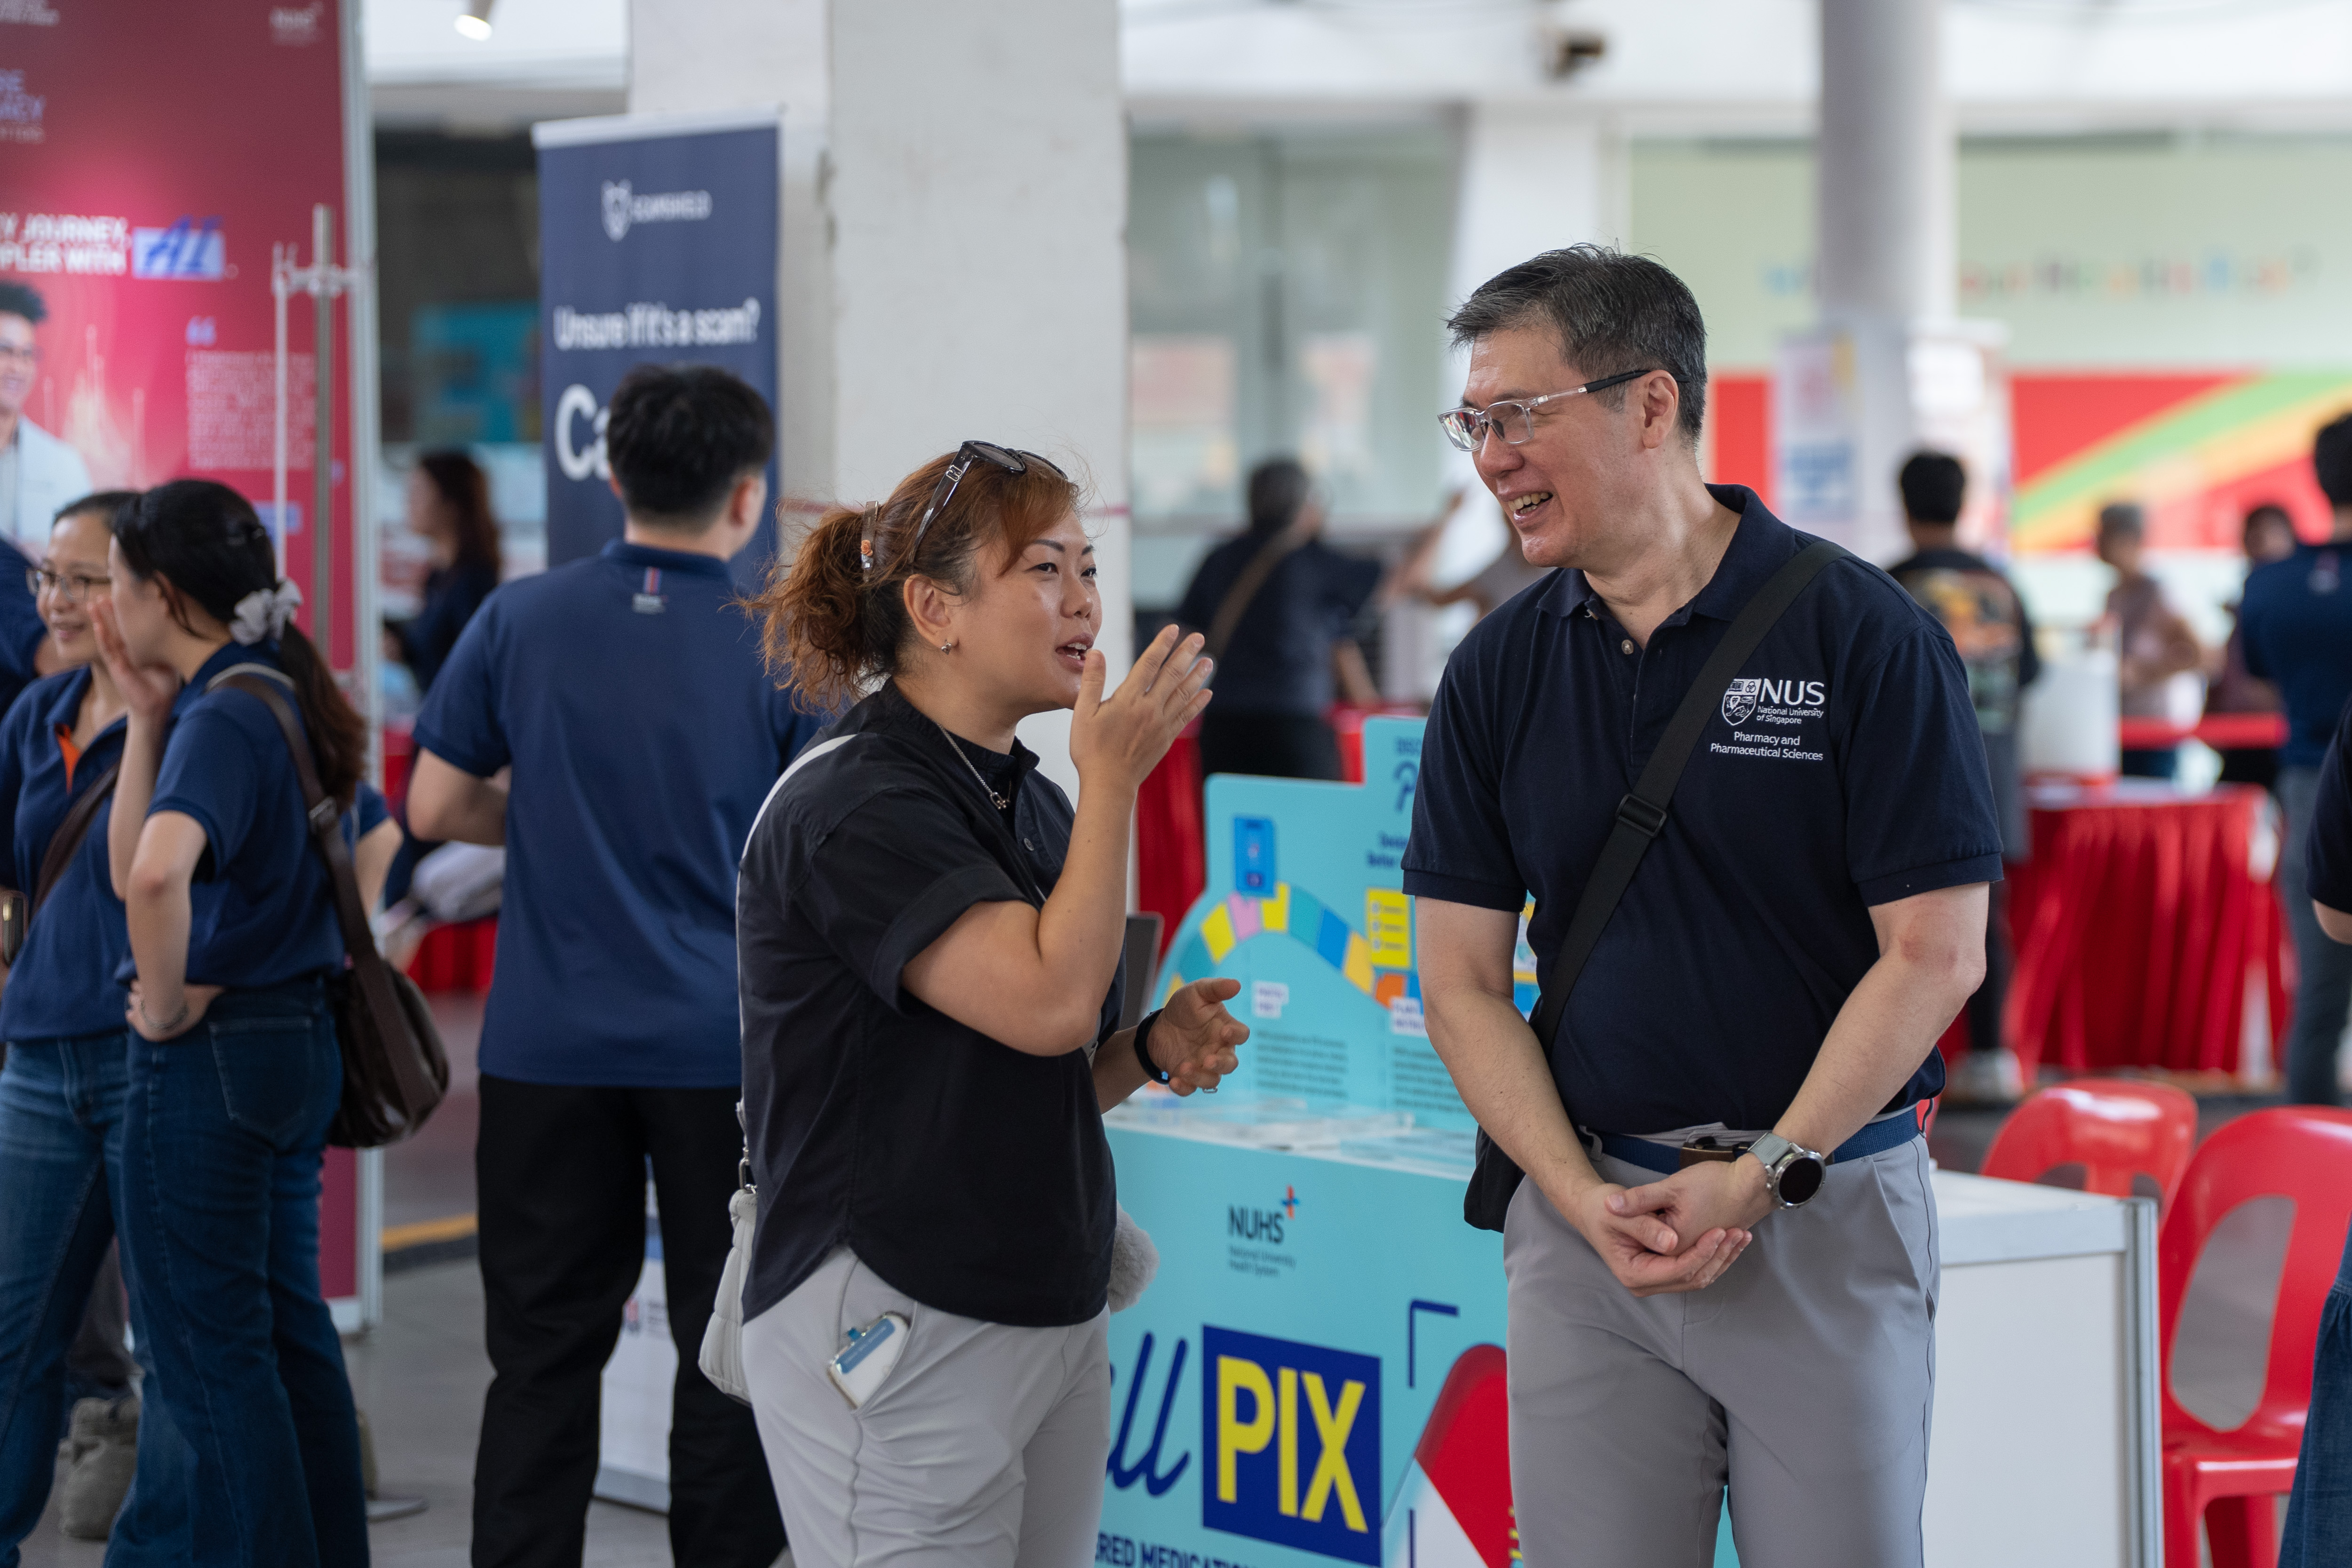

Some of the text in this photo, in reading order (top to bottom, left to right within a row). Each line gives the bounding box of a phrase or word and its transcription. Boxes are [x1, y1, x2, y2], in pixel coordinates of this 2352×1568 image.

[553, 305, 626, 350] Unsure
[694, 296, 762, 346] scam?
[1759, 678, 1825, 705] NUS
[1757, 706, 1824, 718] National University
[1765, 714, 1802, 725] Singapore
[1734, 731, 1801, 746] Pharmacy and
[1710, 742, 1824, 761] Pharmaceutical Sciences
[1228, 1204, 1285, 1244] NUHS
[1216, 1353, 1369, 1535] PIX
